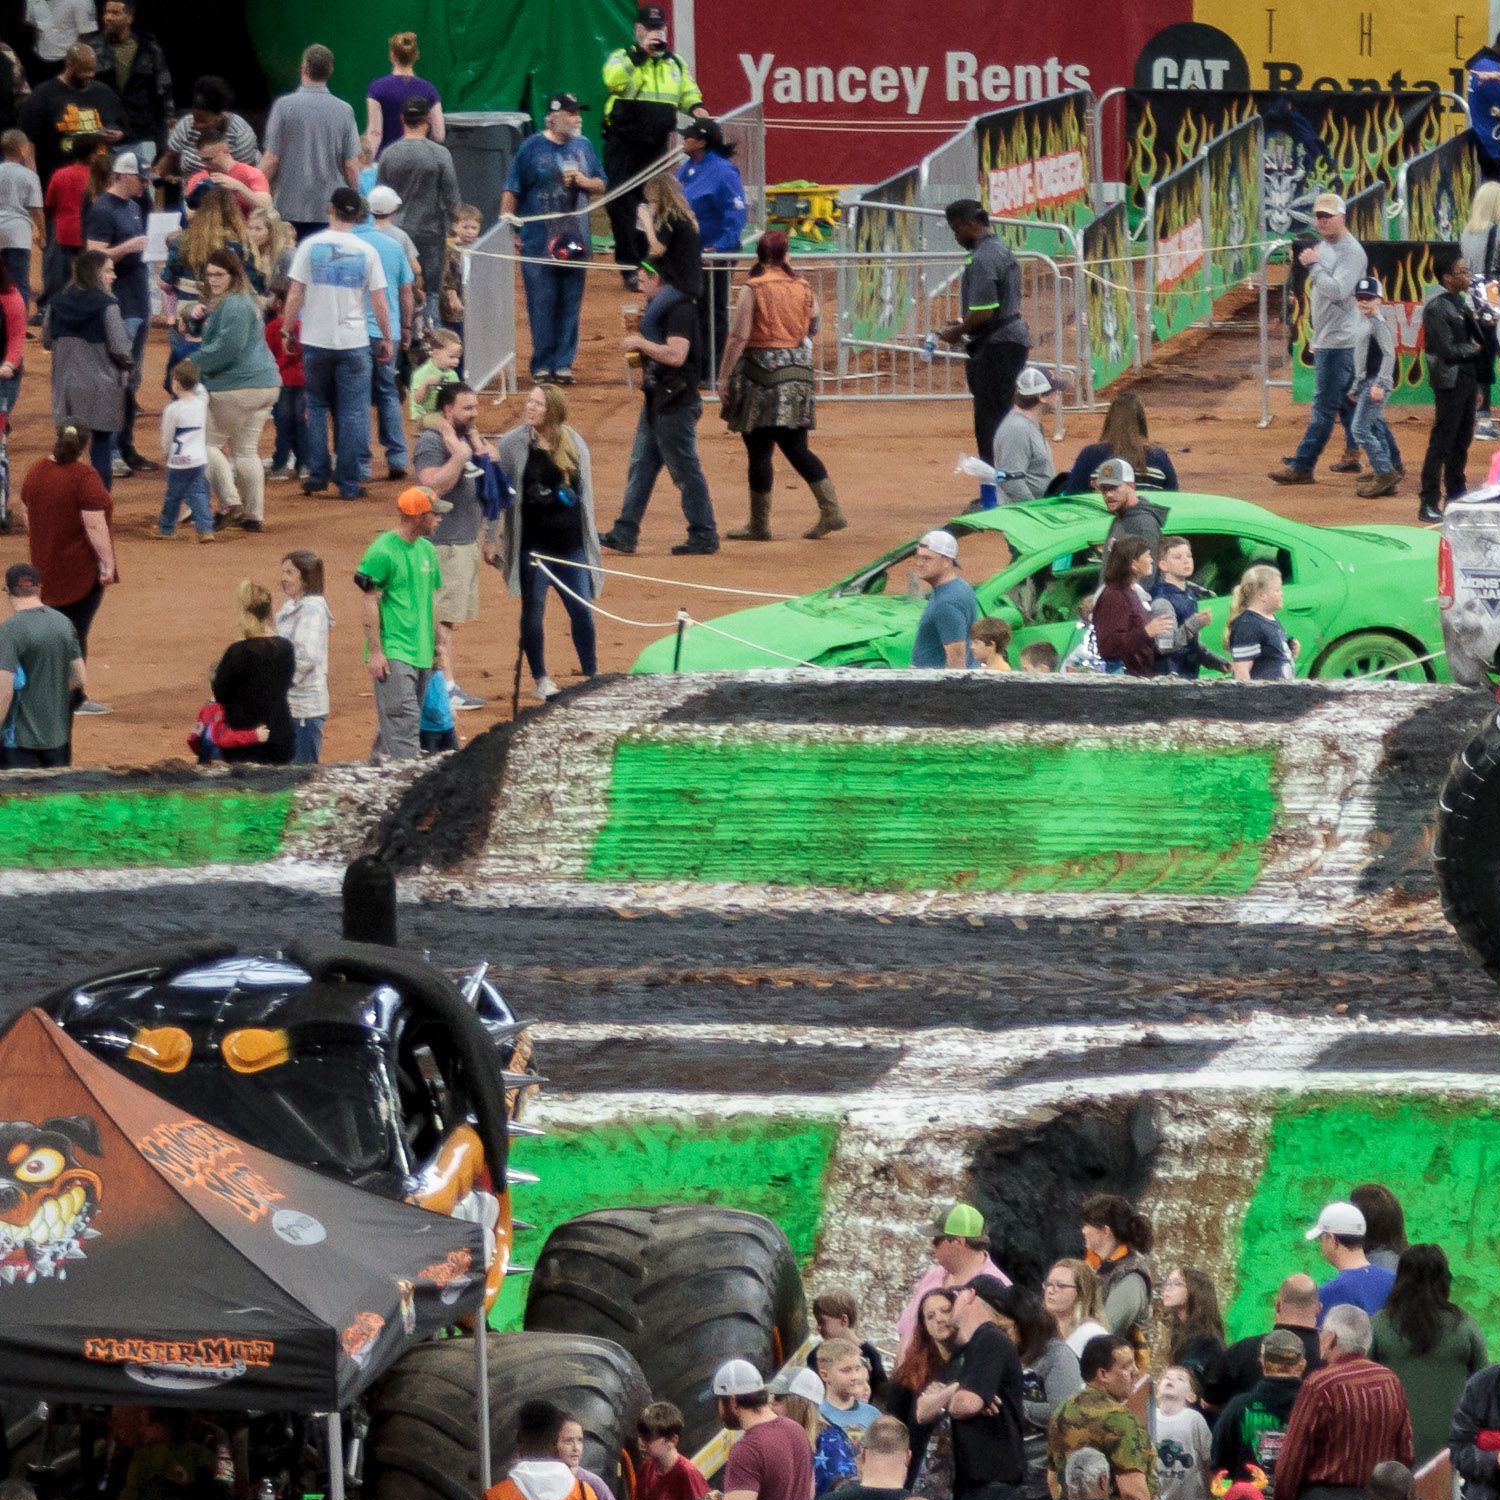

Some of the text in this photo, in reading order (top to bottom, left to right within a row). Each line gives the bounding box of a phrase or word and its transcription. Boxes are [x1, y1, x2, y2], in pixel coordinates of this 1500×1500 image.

[737, 50, 1092, 115] Yancey Rents
[1151, 57, 1231, 90] CAT
[84, 1336, 275, 1368] MONSTER MUTT
